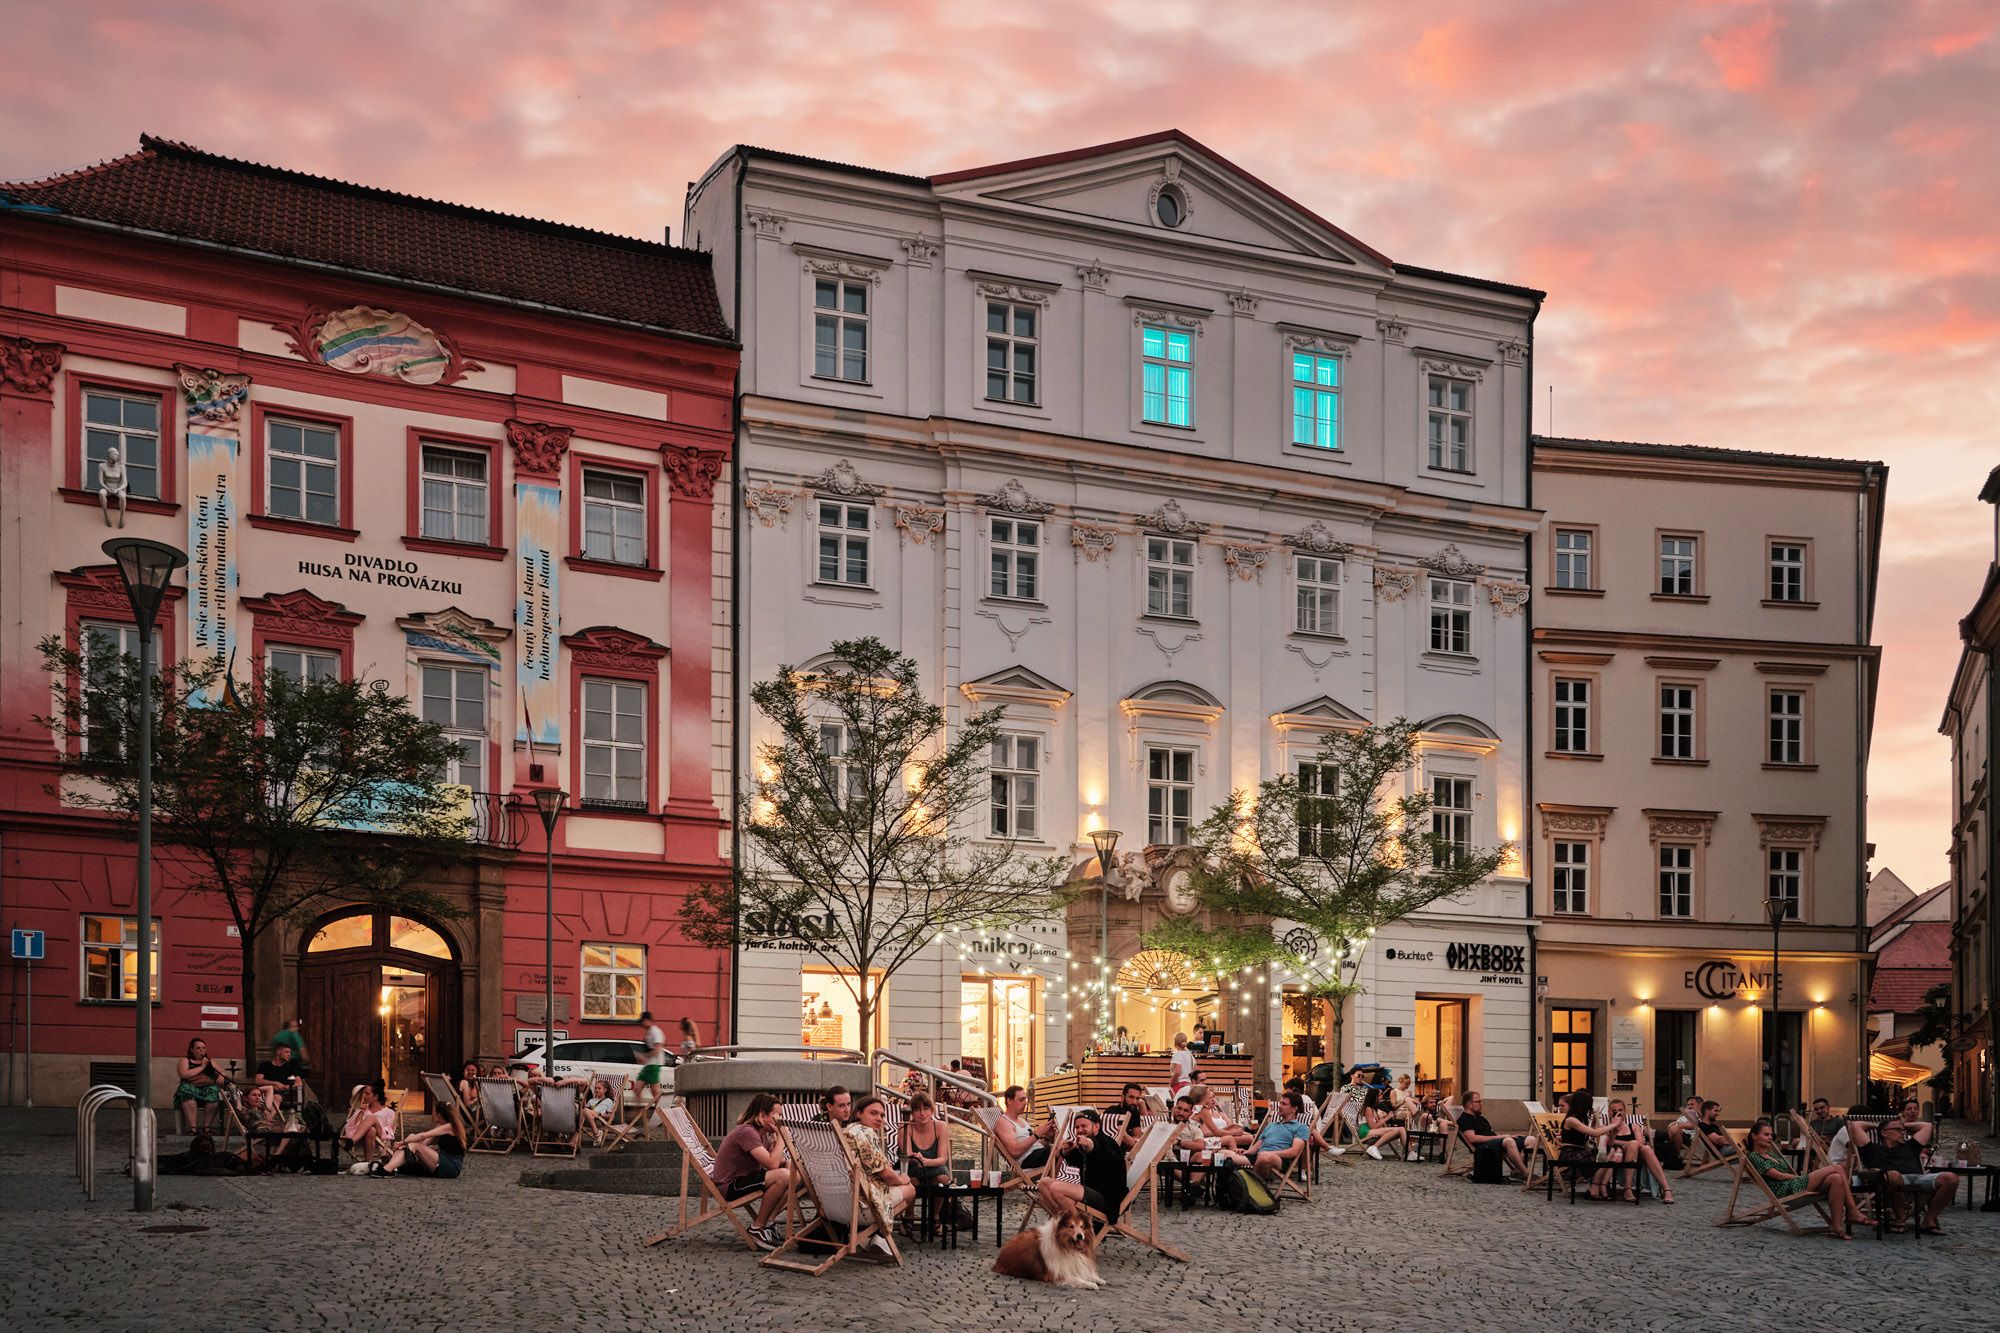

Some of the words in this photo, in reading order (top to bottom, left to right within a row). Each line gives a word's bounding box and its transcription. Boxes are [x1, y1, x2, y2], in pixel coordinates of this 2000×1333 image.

[195, 494, 208, 529] čtení
[195, 533, 208, 608] autorského
[298, 561, 343, 579] HUSA
[349, 568, 371, 583] NA
[377, 572, 462, 595] PROVÁZKU
[344, 553, 418, 574] DIVADLO
[523, 556, 534, 597] Island
[523, 600, 534, 627] host
[523, 629, 537, 670] čestný
[1397, 949, 1426, 961] Buchta
[1480, 974, 1497, 983] JINÝ
[1499, 976, 1524, 985] HOTEL
[542, 1065, 572, 1073] pess
